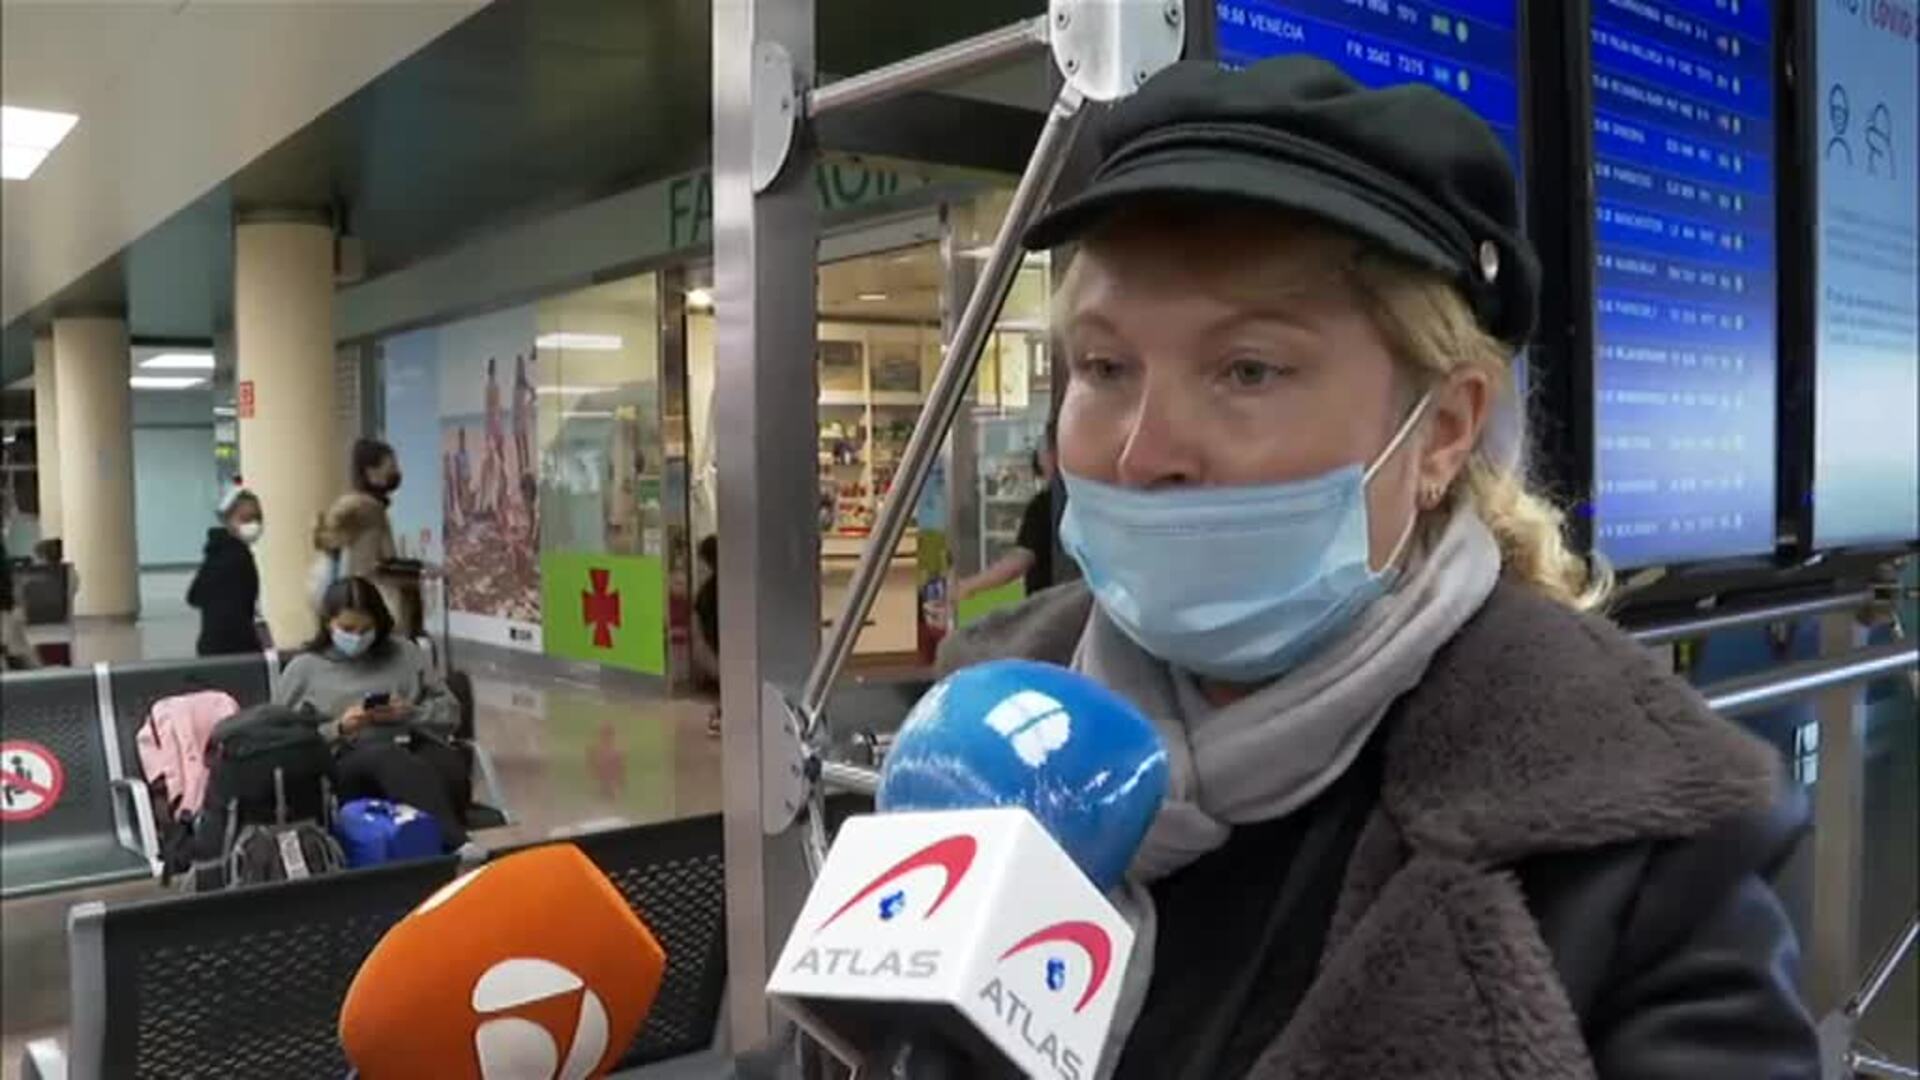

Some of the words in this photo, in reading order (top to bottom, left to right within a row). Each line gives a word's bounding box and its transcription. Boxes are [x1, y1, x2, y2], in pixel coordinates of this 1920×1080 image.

[1249, 10, 1306, 42] VENECIA
[791, 949, 941, 978] ATLAS
[979, 977, 1083, 1080] ATLAS
